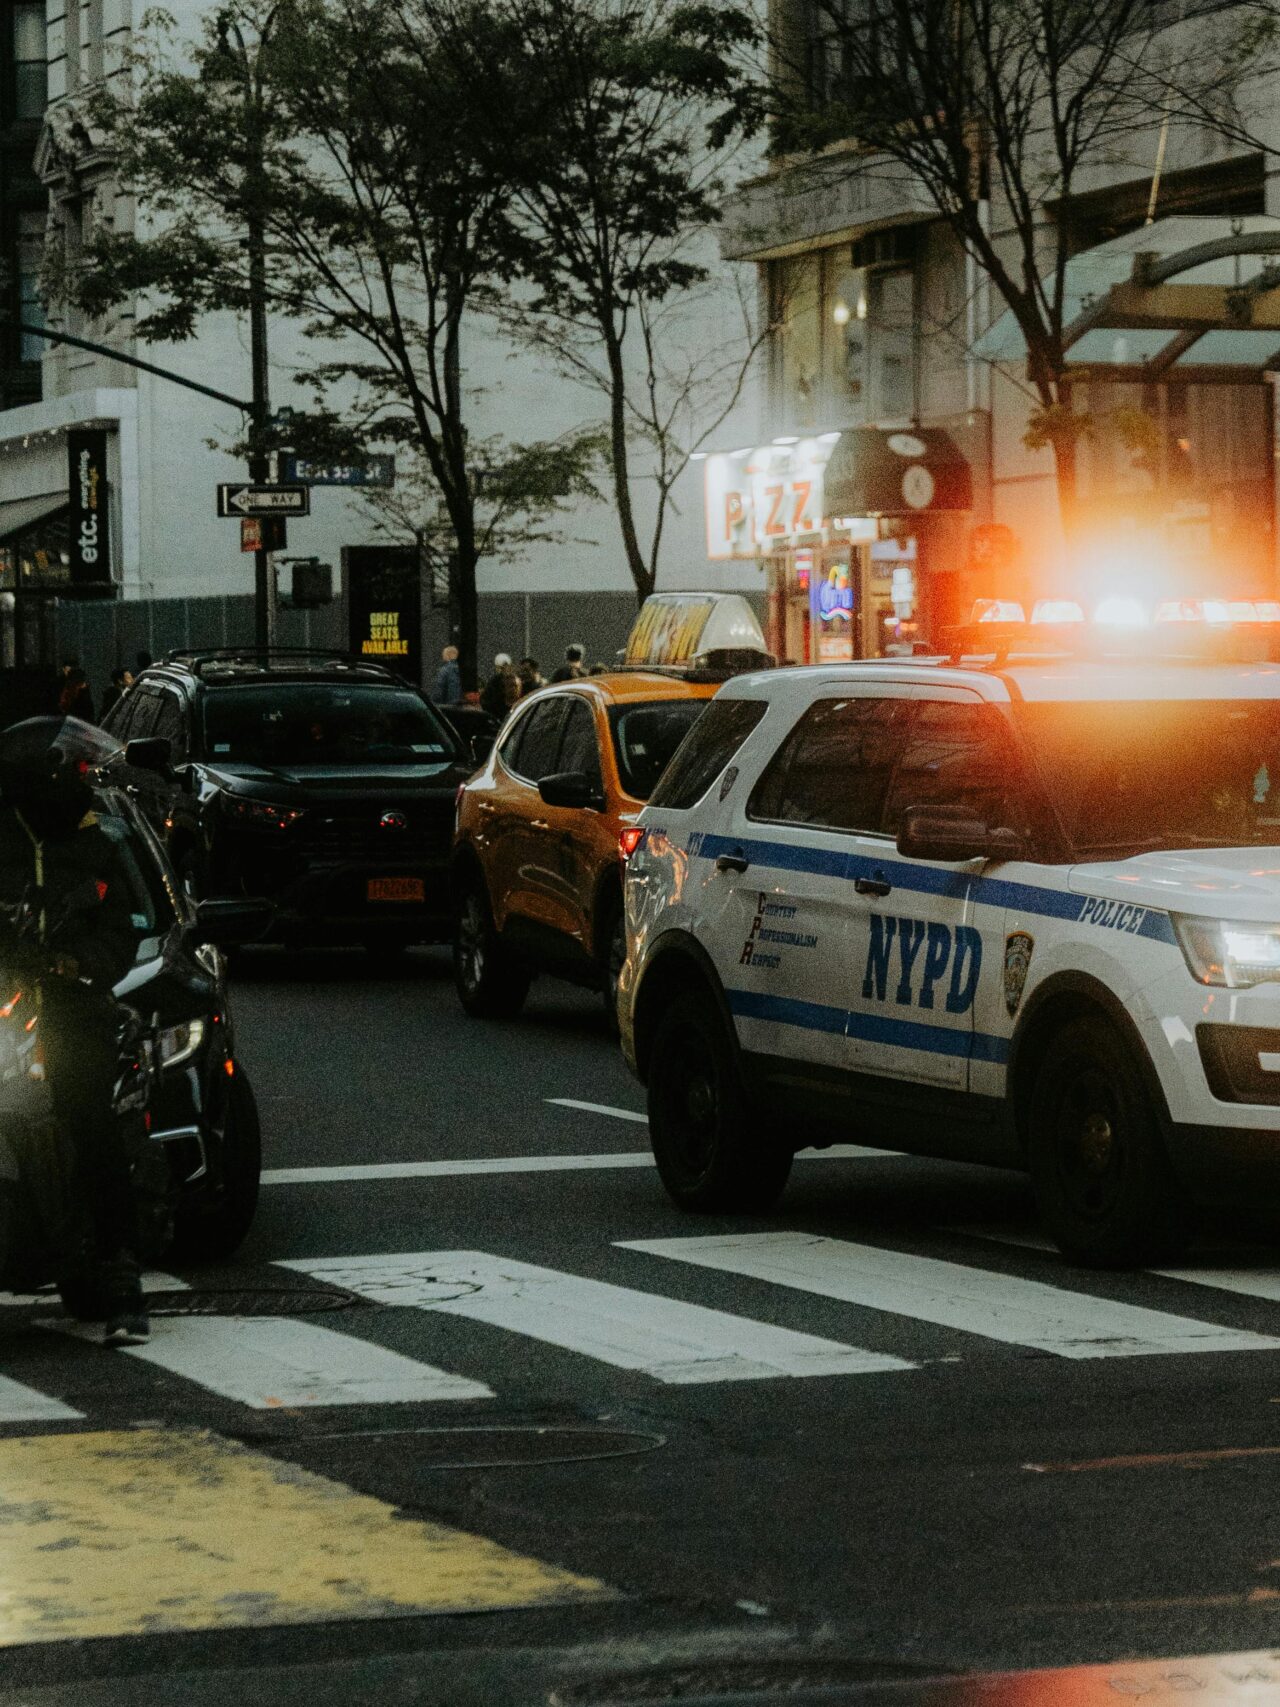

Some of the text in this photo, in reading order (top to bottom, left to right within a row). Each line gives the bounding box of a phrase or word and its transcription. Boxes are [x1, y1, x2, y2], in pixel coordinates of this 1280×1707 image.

[238, 495, 294, 505] ONE WAY
[77, 513, 99, 564] etc.
[369, 612, 400, 625] GREAT
[370, 626, 399, 640] SEATS
[362, 640, 408, 654] AVAILABLE
[1078, 896, 1145, 933] POLICE
[861, 914, 983, 1014] NYPD
